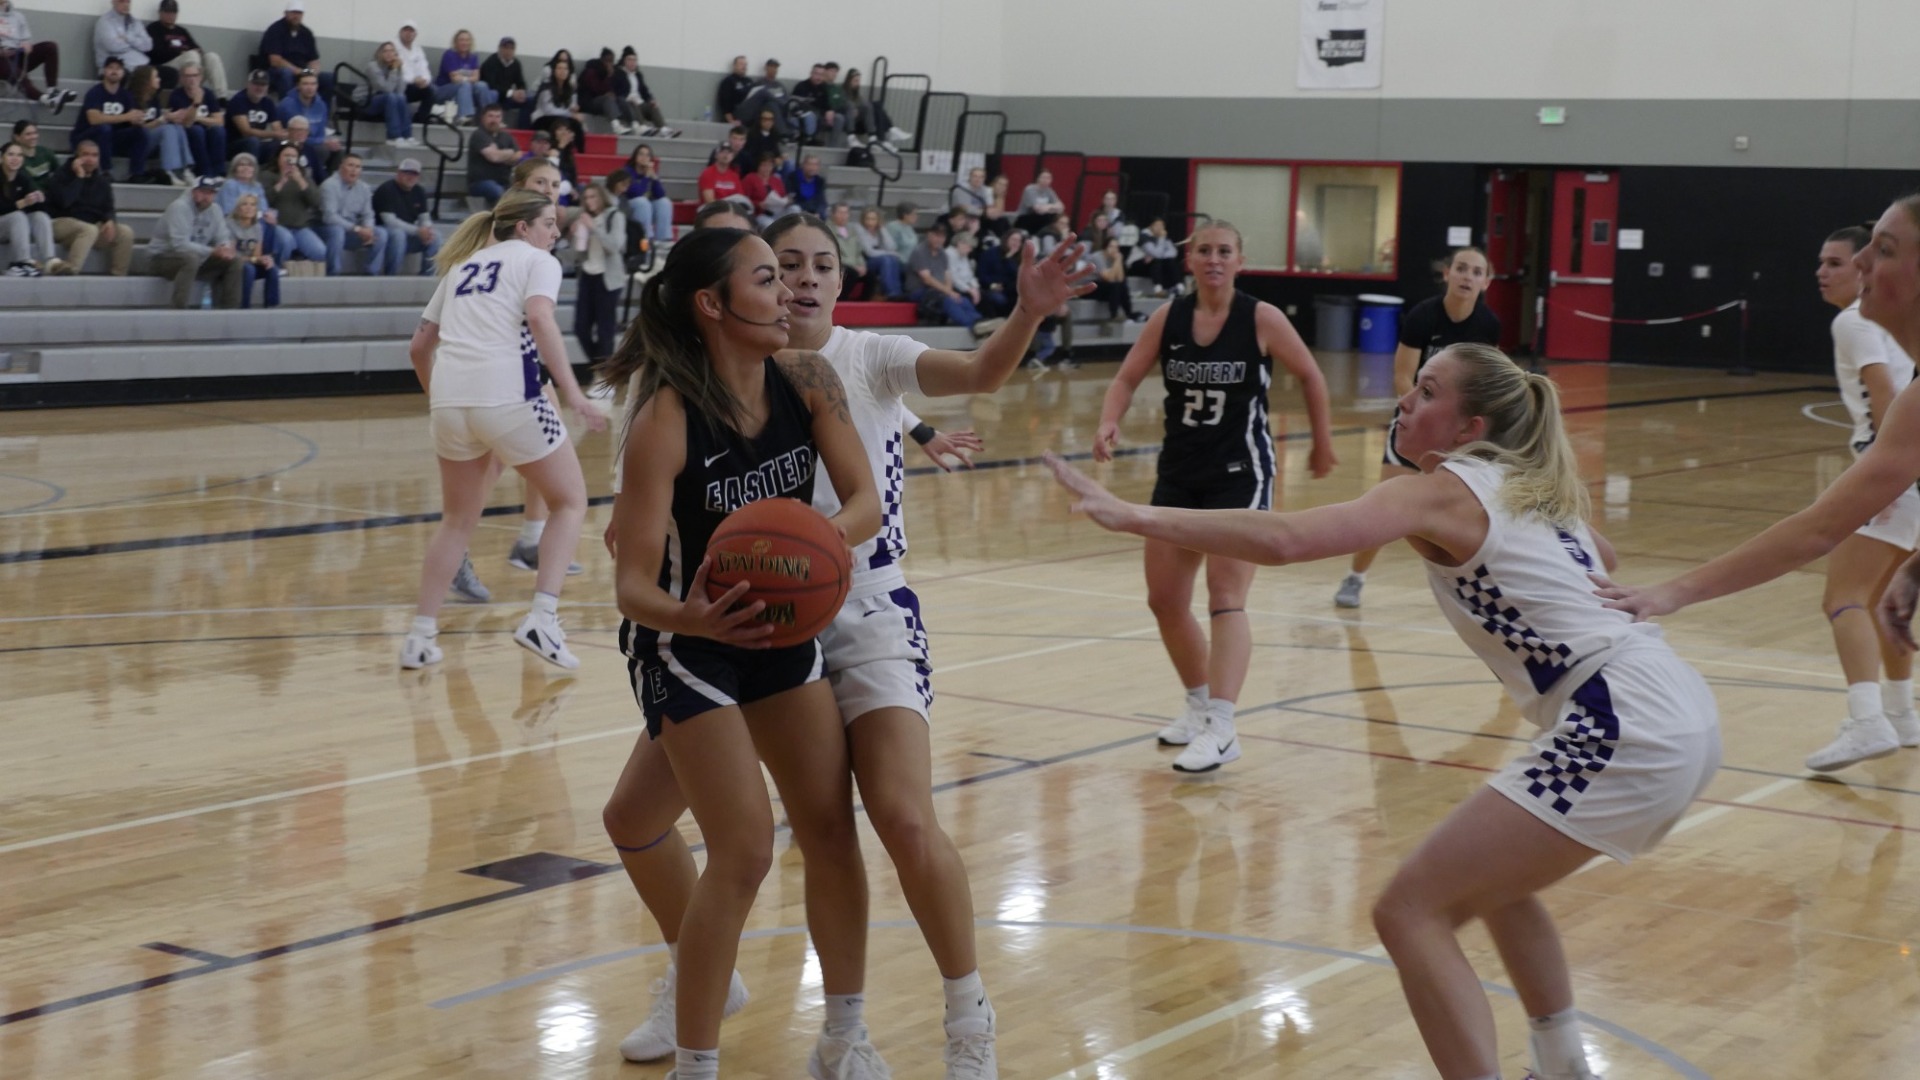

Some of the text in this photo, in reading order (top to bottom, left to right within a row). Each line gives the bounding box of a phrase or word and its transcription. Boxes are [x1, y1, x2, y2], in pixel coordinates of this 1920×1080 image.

[455, 261, 502, 297] 23
[1166, 359, 1247, 384] EASTERN
[1182, 388, 1227, 427] 23
[705, 443, 817, 513] EASTER
[647, 666, 668, 704] E
